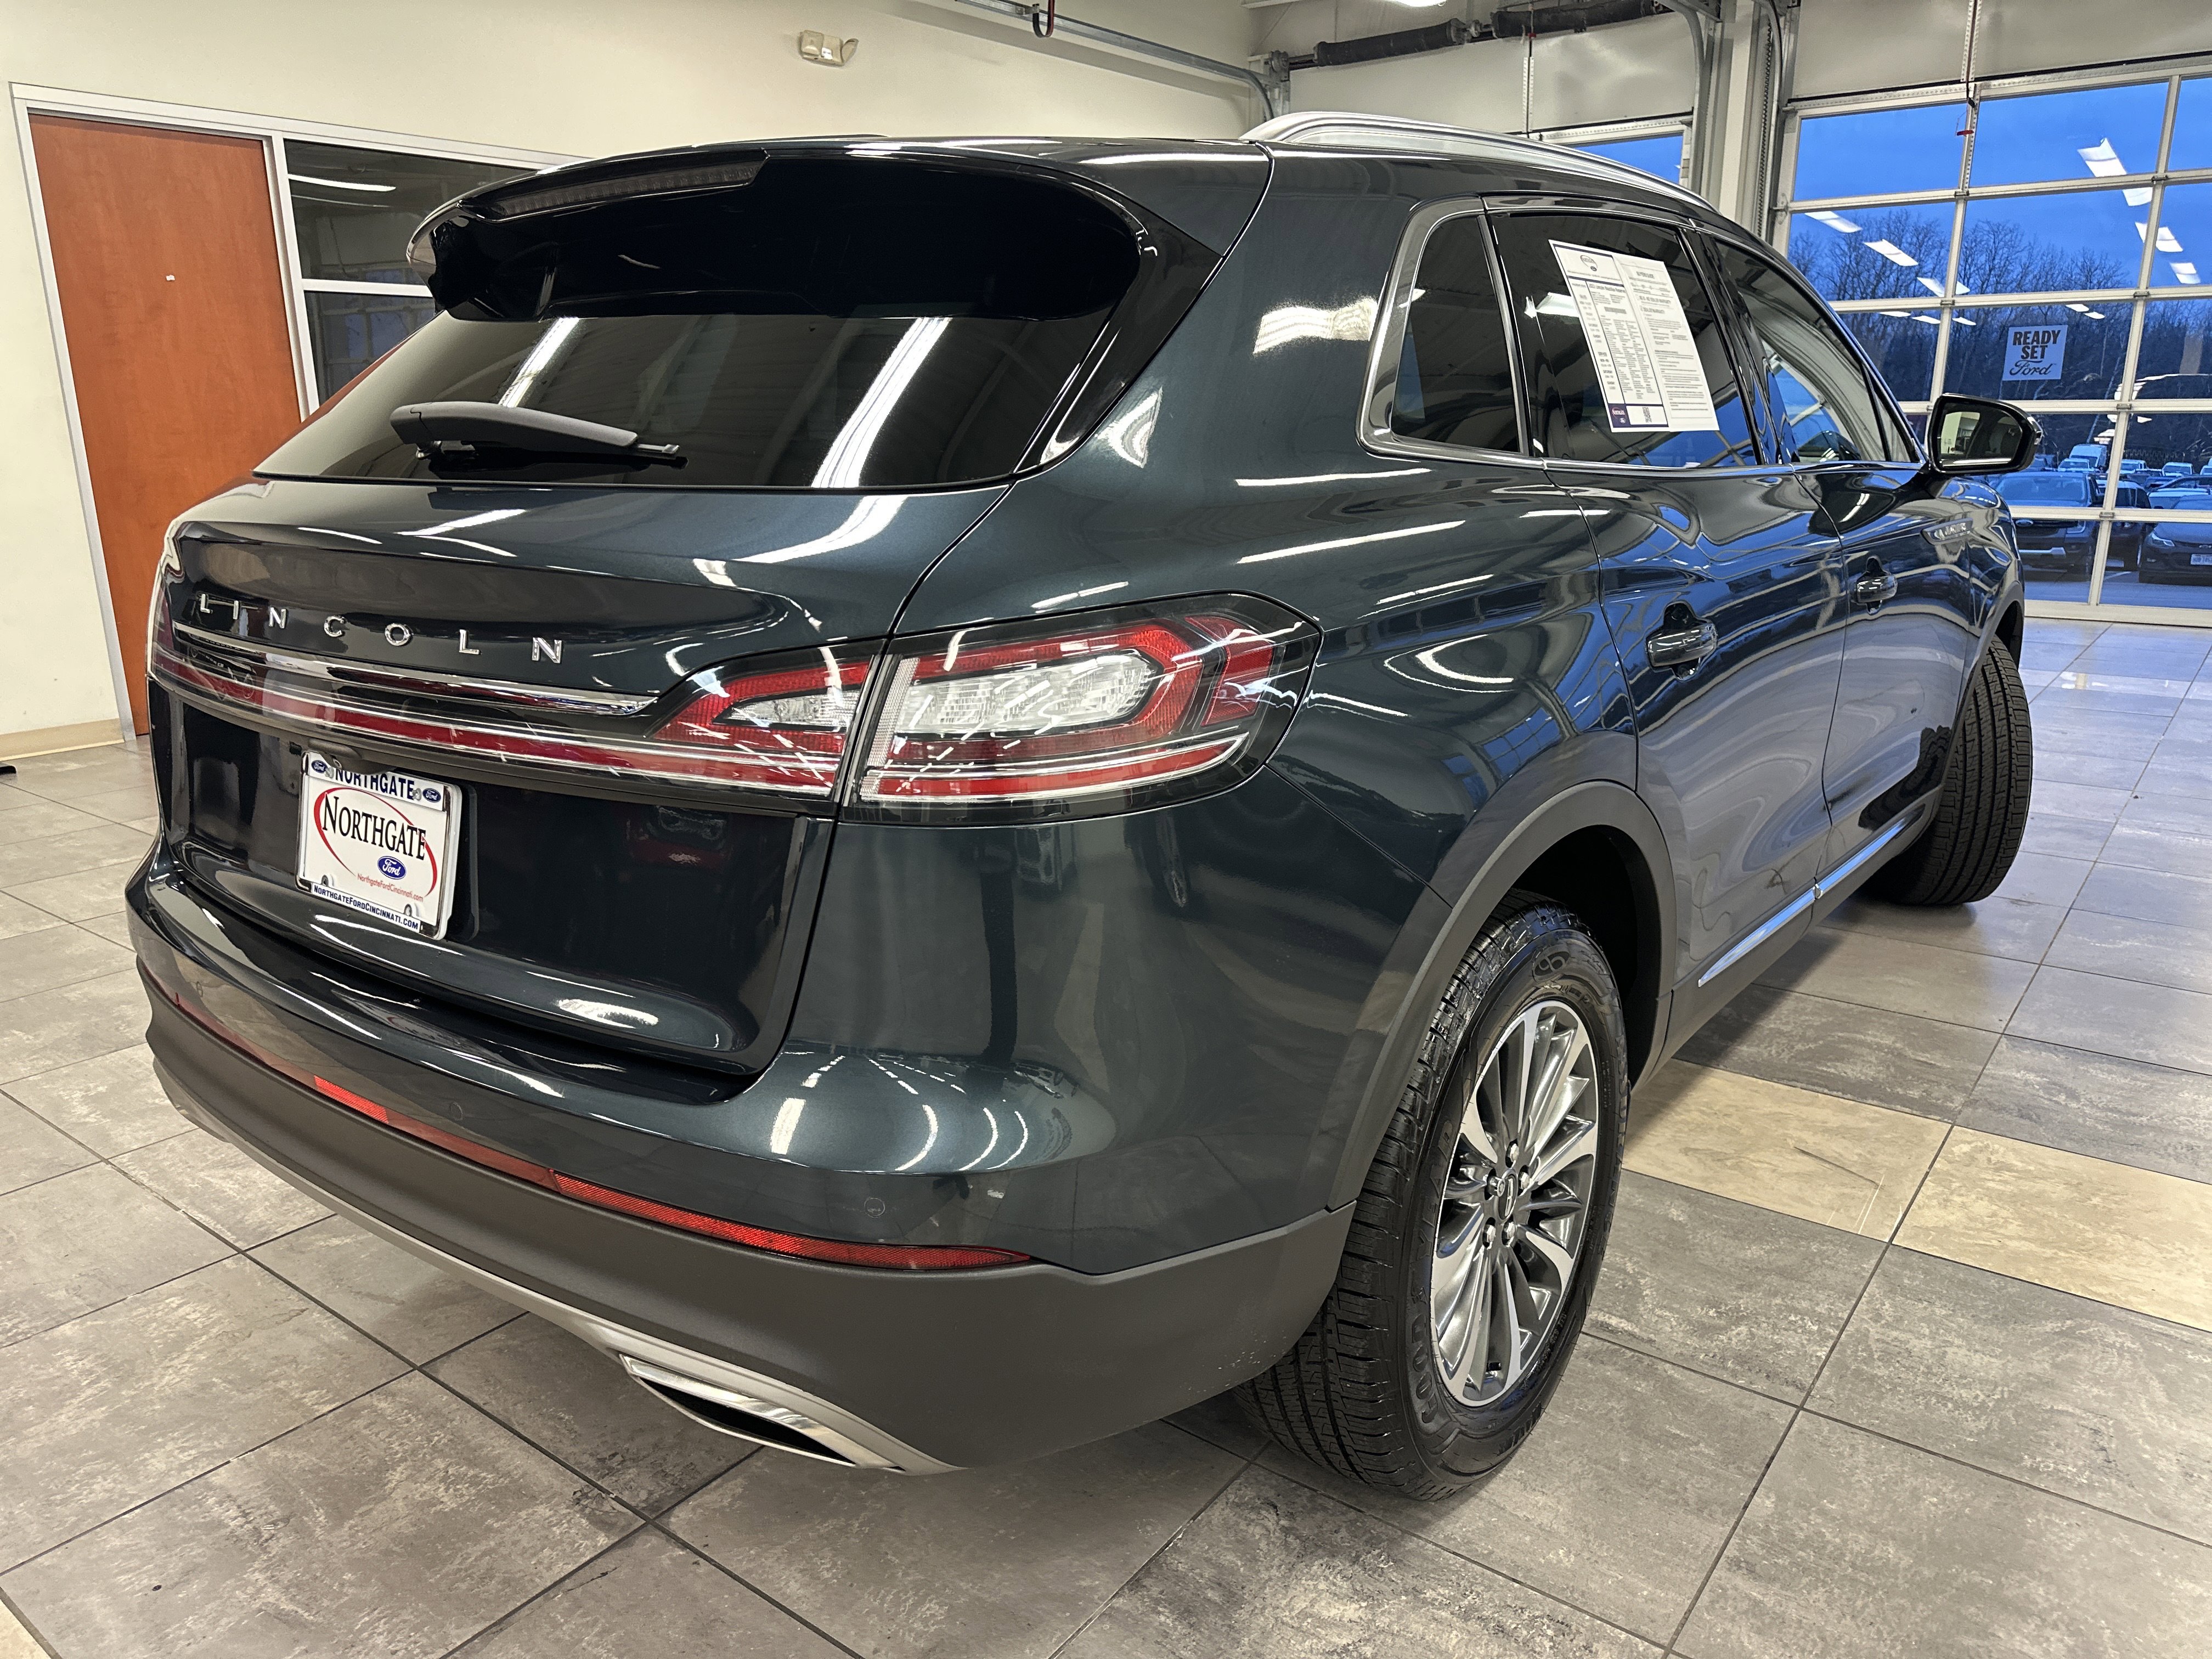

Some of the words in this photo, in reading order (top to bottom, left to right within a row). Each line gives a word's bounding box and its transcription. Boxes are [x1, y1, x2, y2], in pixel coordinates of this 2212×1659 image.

[2012, 330, 2061, 346] READY
[2021, 345, 2048, 359] SET
[2009, 359, 2053, 376] Ford
[199, 593, 563, 664] LINCOLN
[335, 769, 415, 800] NORTHGATE
[424, 789, 440, 802] Ford
[380, 857, 404, 877] Ford
[357, 873, 424, 902] NorthgateFordCincinnati.com
